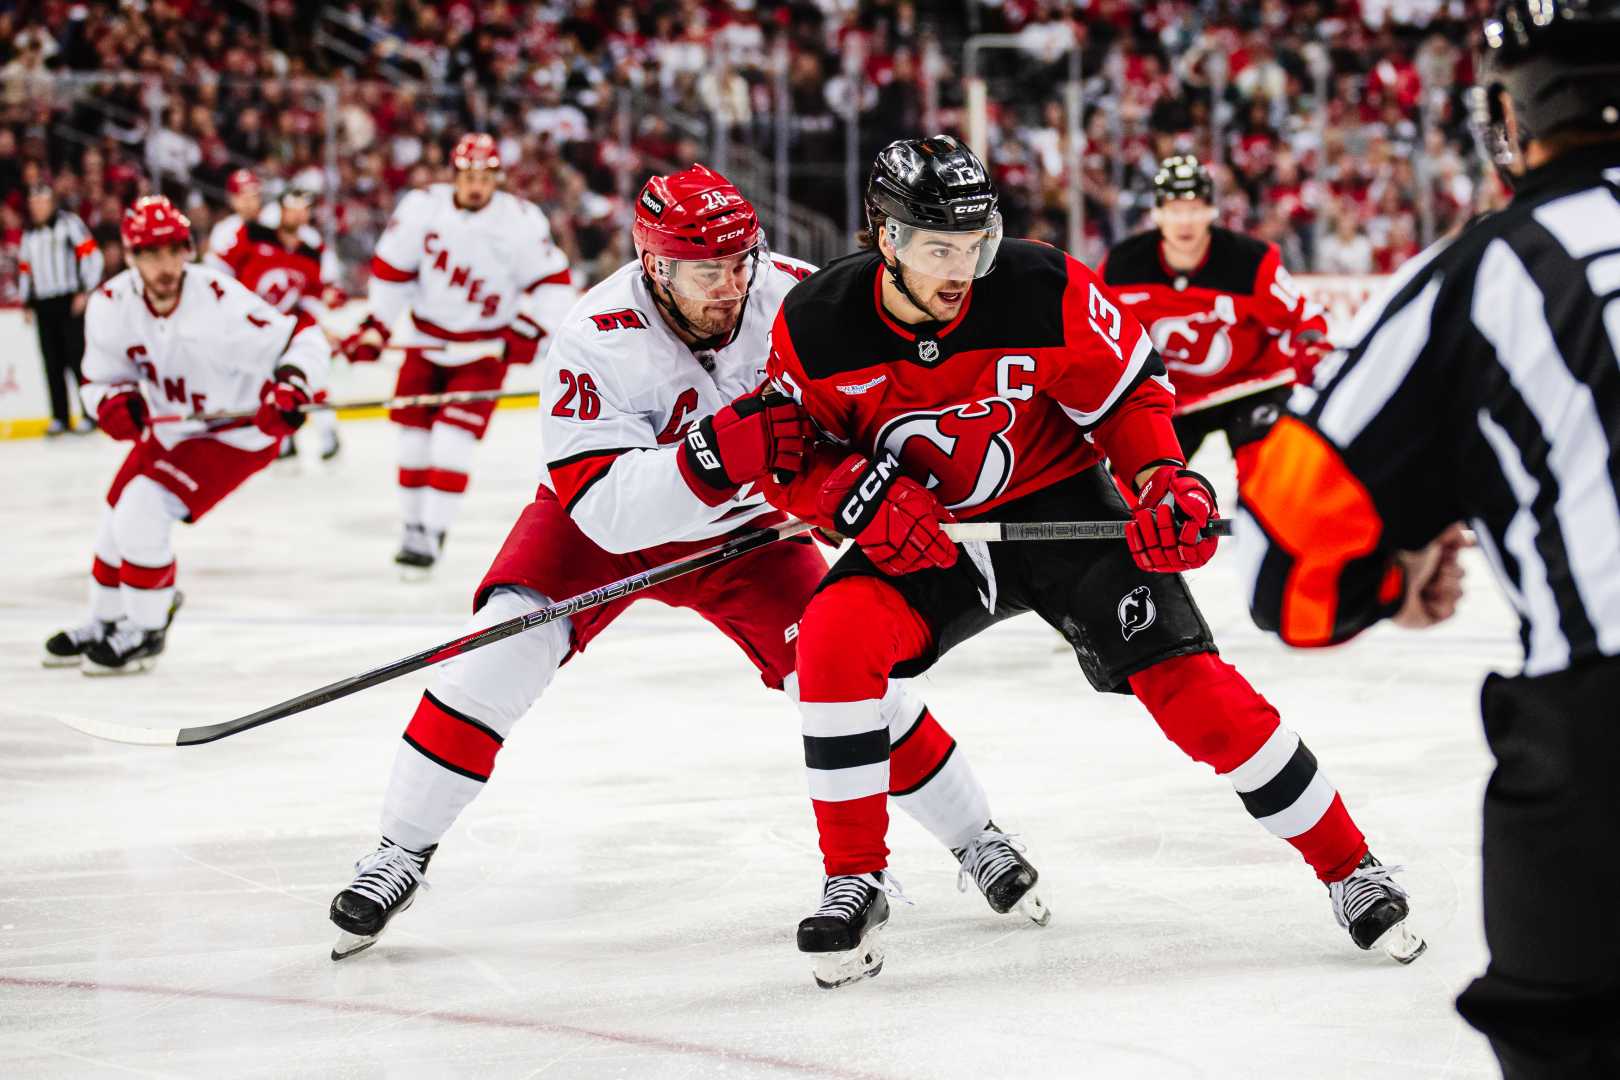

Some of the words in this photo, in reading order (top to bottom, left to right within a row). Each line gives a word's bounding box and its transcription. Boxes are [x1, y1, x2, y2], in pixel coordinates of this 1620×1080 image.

[700, 190, 728, 210] 26
[954, 202, 988, 214] CCM
[717, 227, 745, 243] CCM
[424, 233, 501, 319] CANES
[1088, 282, 1123, 361] 13
[551, 368, 601, 420] 26
[996, 354, 1036, 401] C
[842, 453, 900, 525] CCM
